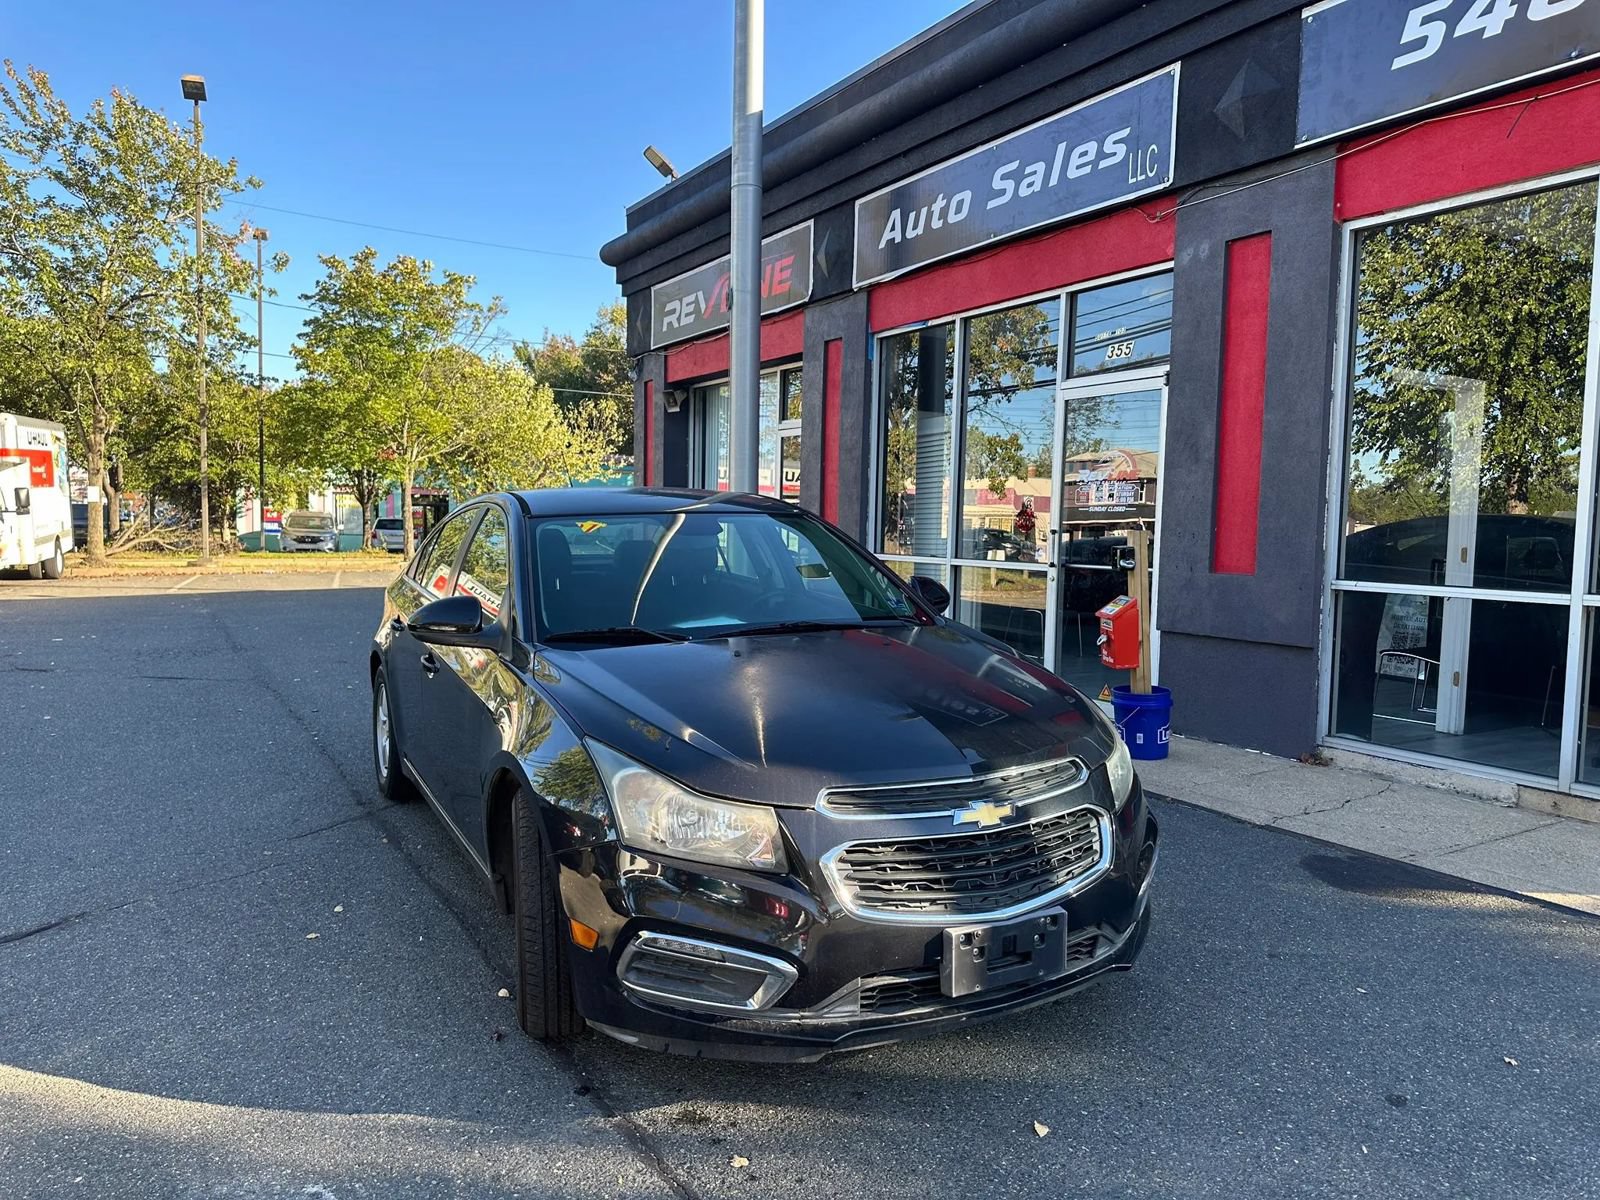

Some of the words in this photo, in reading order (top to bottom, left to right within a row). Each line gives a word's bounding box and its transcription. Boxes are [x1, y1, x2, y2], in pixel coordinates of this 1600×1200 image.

[878, 189, 972, 249] Auto
[986, 127, 1131, 210] Sales
[1128, 144, 1158, 184] LLC
[1107, 342, 1133, 359] 355
